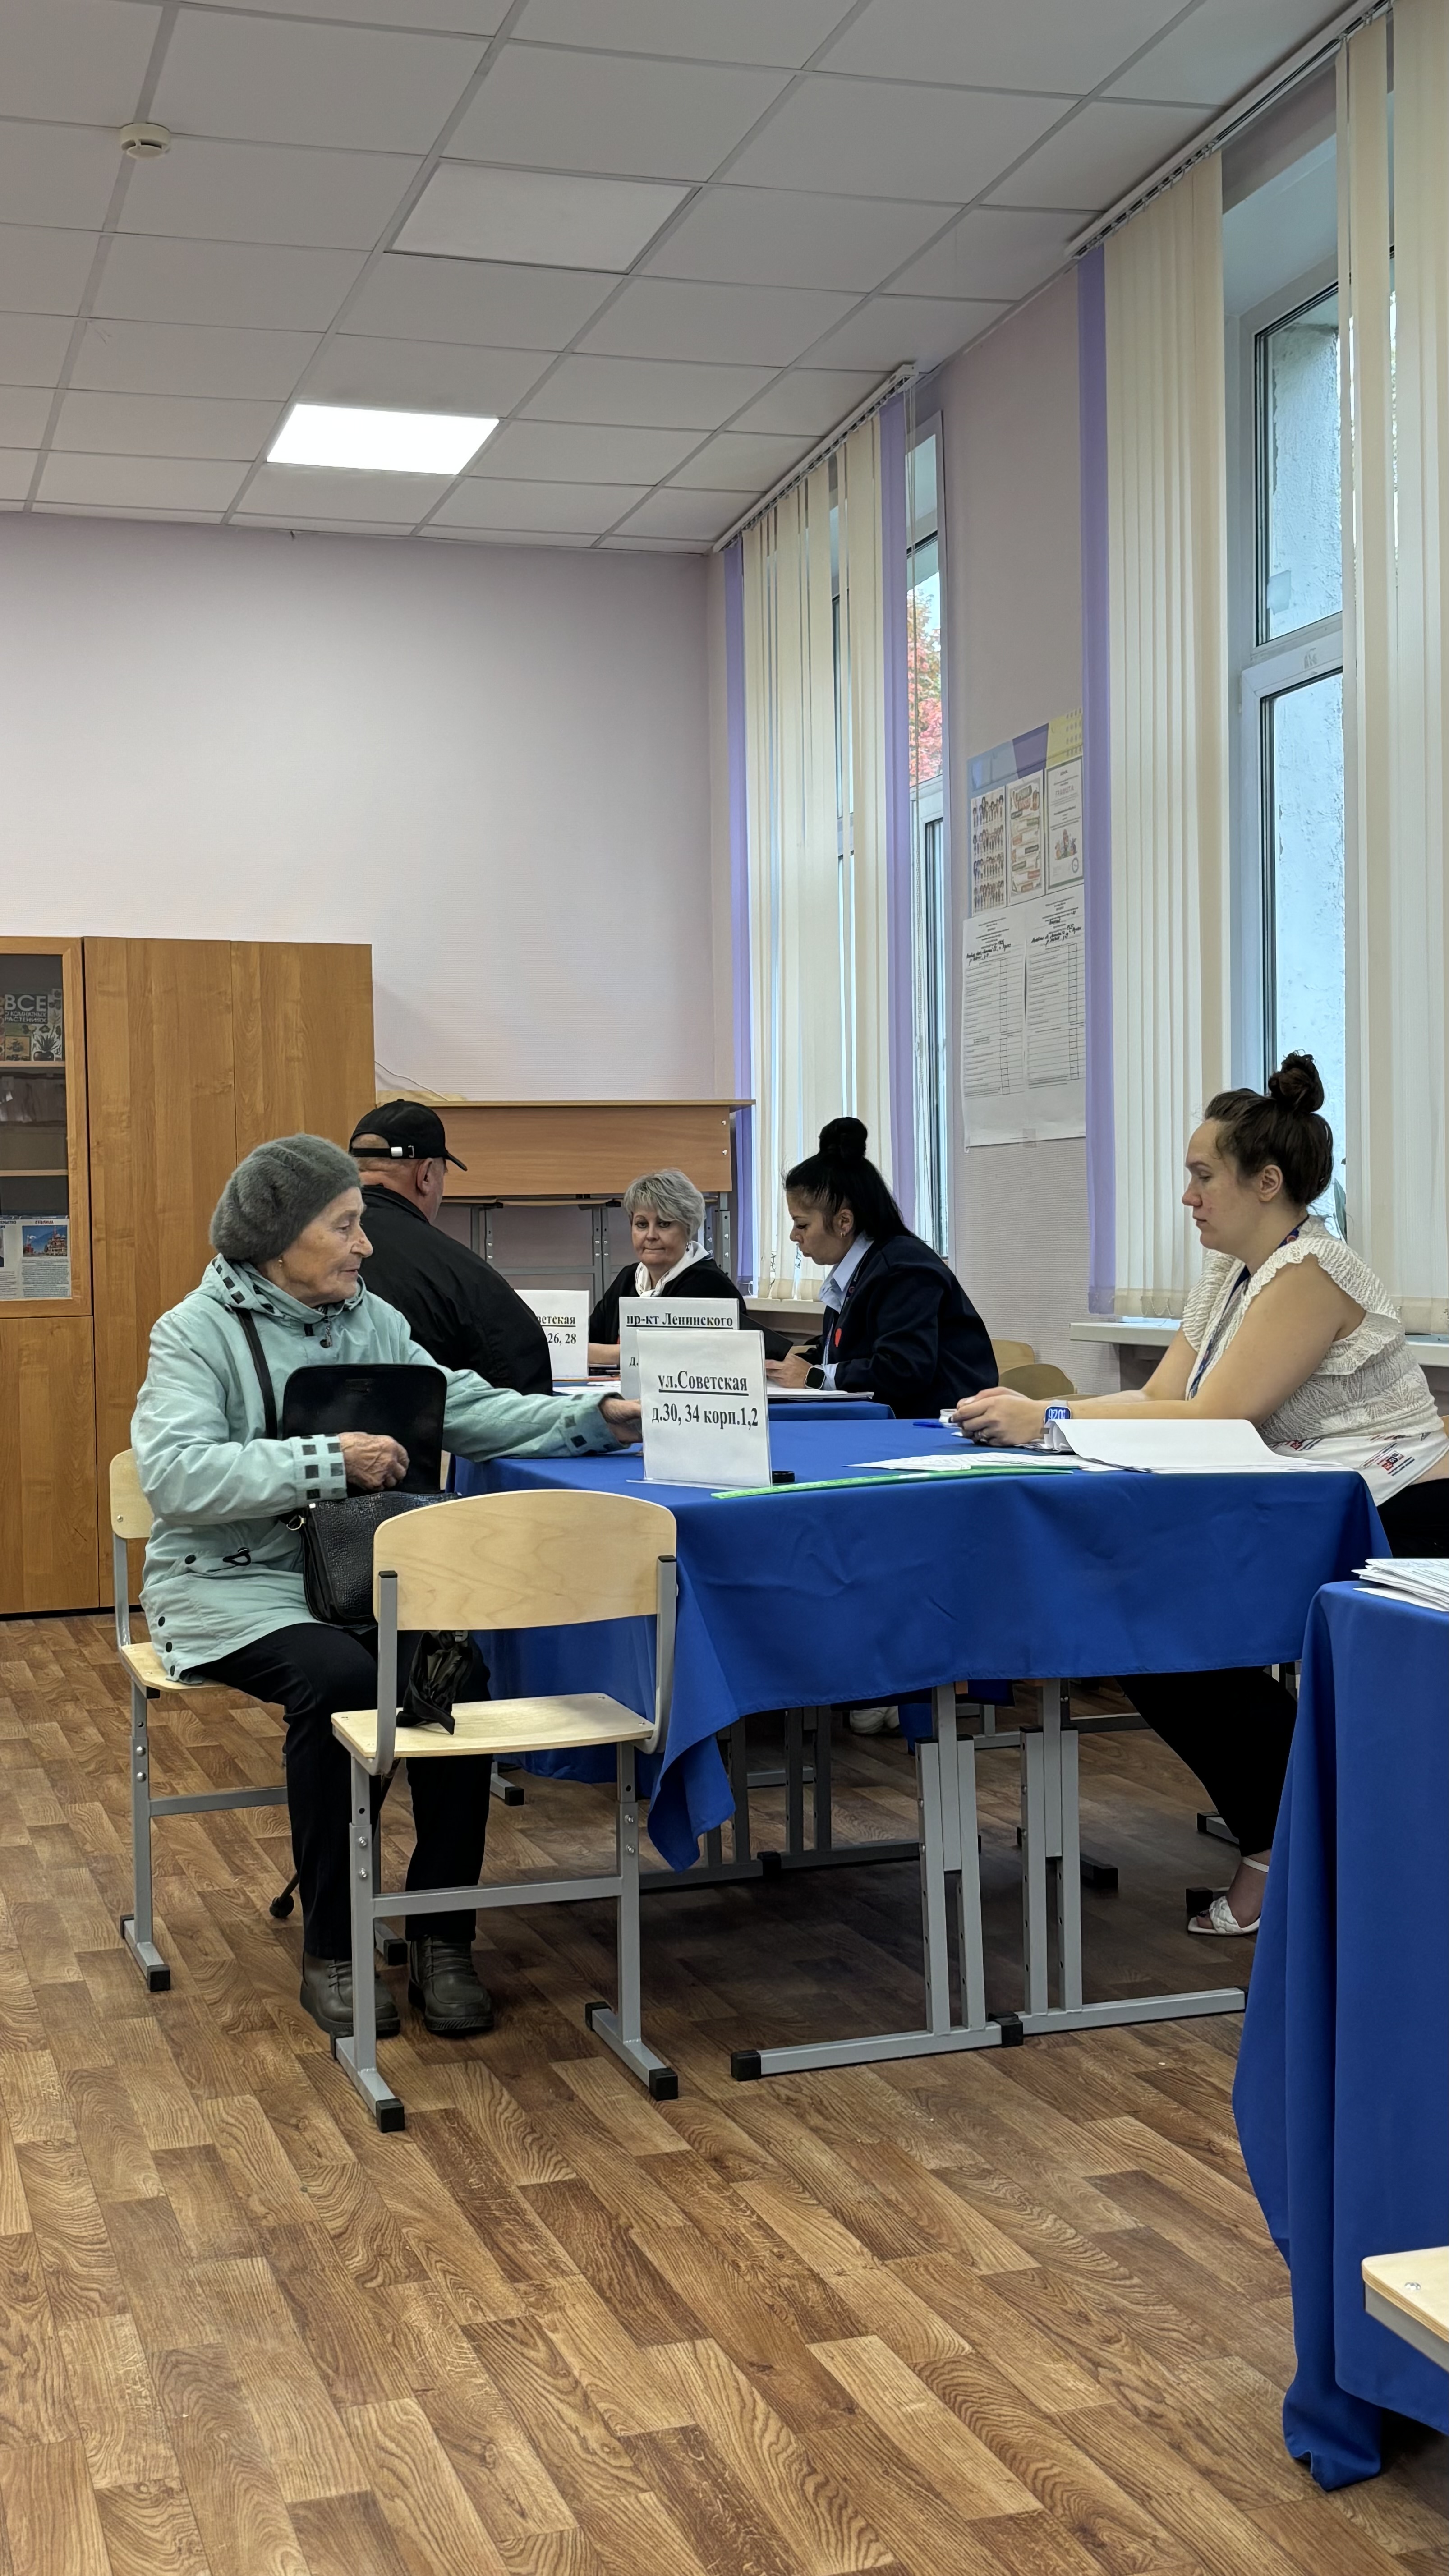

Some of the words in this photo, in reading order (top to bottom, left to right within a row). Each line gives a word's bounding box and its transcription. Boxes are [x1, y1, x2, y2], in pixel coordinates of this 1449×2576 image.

[5, 994, 46, 1011] ВСЕ
[626, 1316, 659, 1325] пр-кт
[662, 1313, 733, 1326] Ленинского
[565, 1333, 576, 1344] 28
[658, 1371, 747, 1391] ул.Советская
[652, 1403, 681, 1426] д.30,
[685, 1404, 699, 1422] 34
[704, 1407, 758, 1430] корп.1,2
